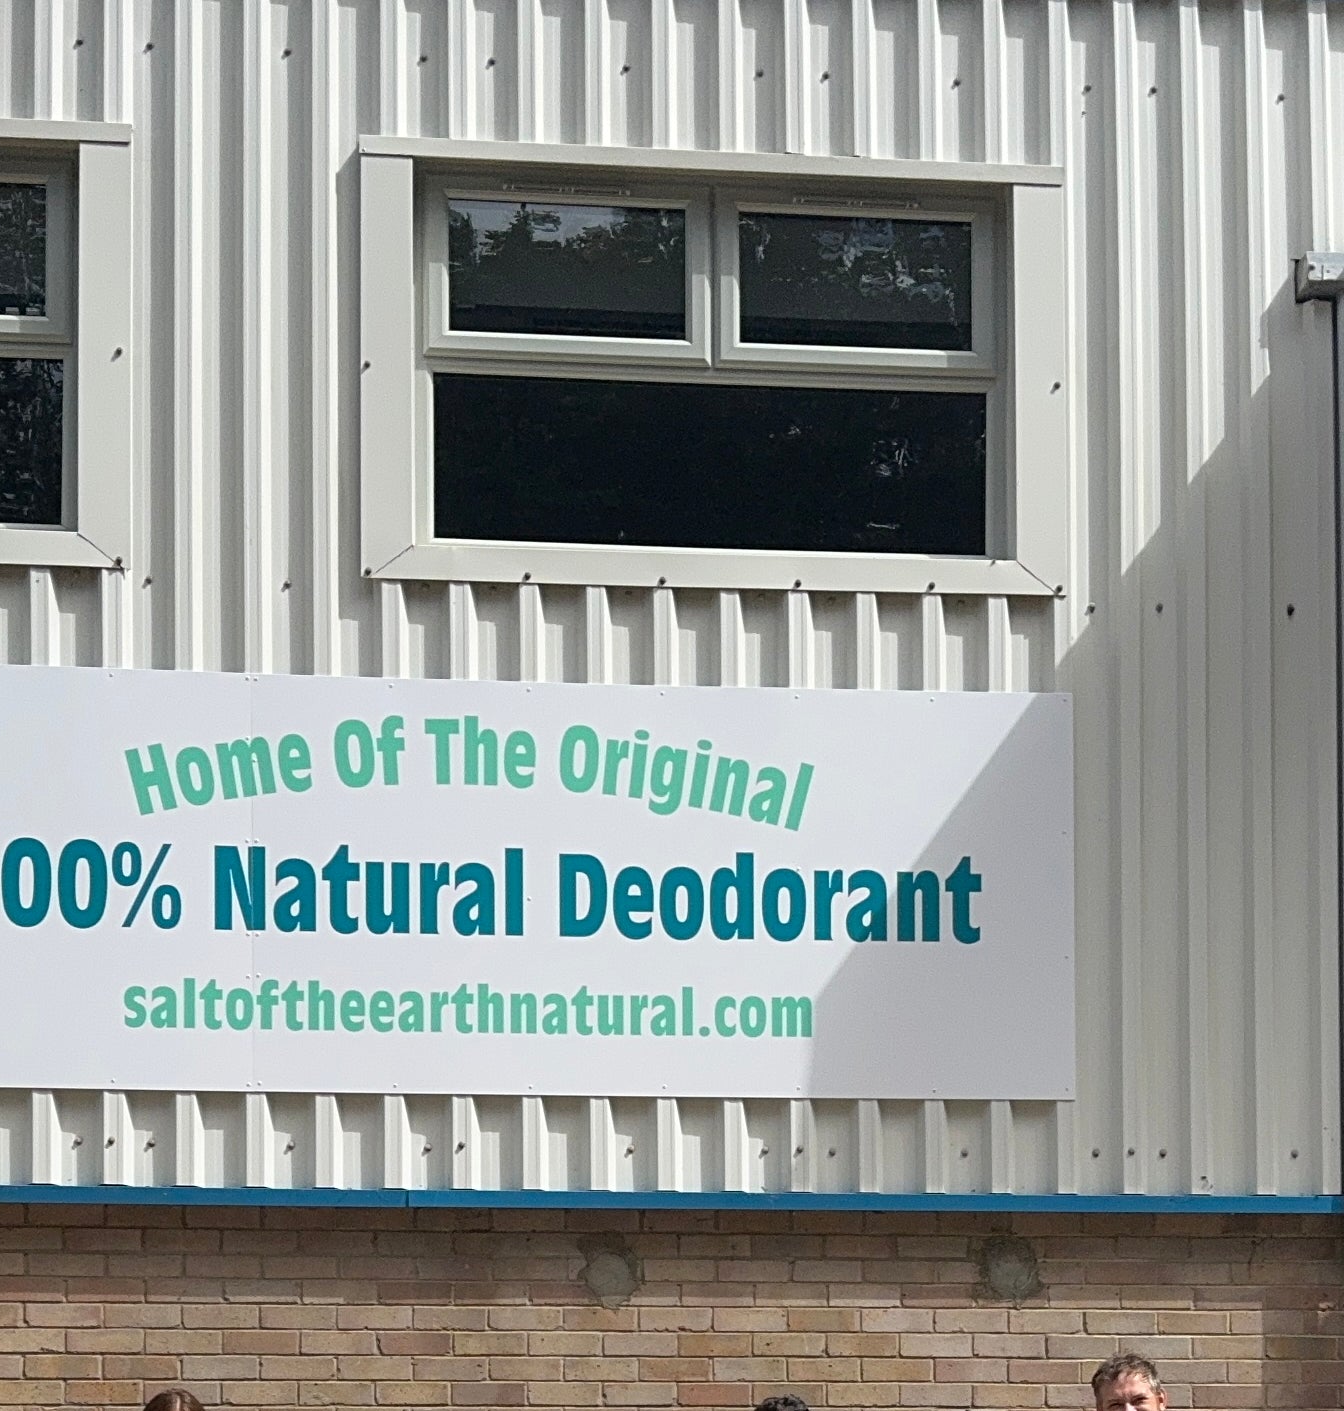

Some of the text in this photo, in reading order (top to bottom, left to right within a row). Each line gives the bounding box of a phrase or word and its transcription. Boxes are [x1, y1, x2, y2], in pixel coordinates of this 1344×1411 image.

[126, 716, 813, 829] Home Of The Original
[215, 845, 523, 936] Natural
[560, 853, 981, 944] Deodorant
[125, 979, 811, 1037] saltoftheearthnatural.com
